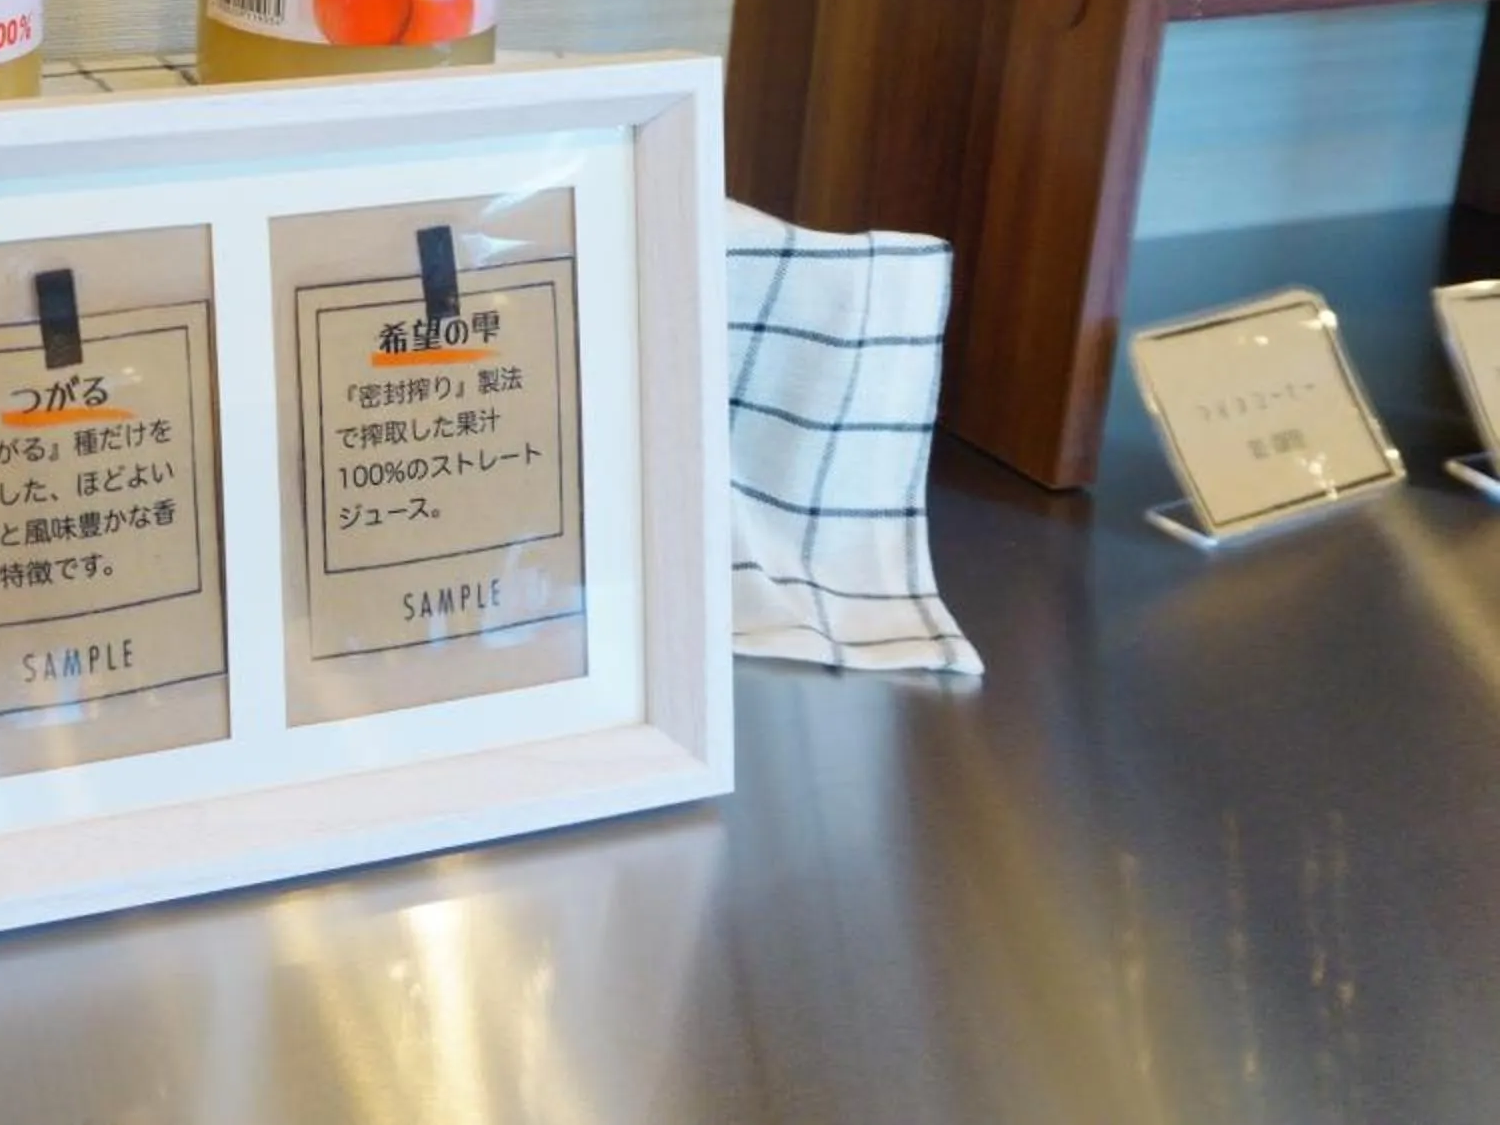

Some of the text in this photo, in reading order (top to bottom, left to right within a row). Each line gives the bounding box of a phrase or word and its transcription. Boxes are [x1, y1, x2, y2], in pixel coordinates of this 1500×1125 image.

[378, 311, 501, 354] 希望の雫
[10, 375, 110, 413] つがる
[335, 407, 501, 451] で搾取した果汁
[339, 442, 543, 491] 100%のストレート
[339, 496, 441, 531] ジュース。
[403, 578, 501, 621] SAMPLE
[23, 638, 134, 683] SAMPLE
